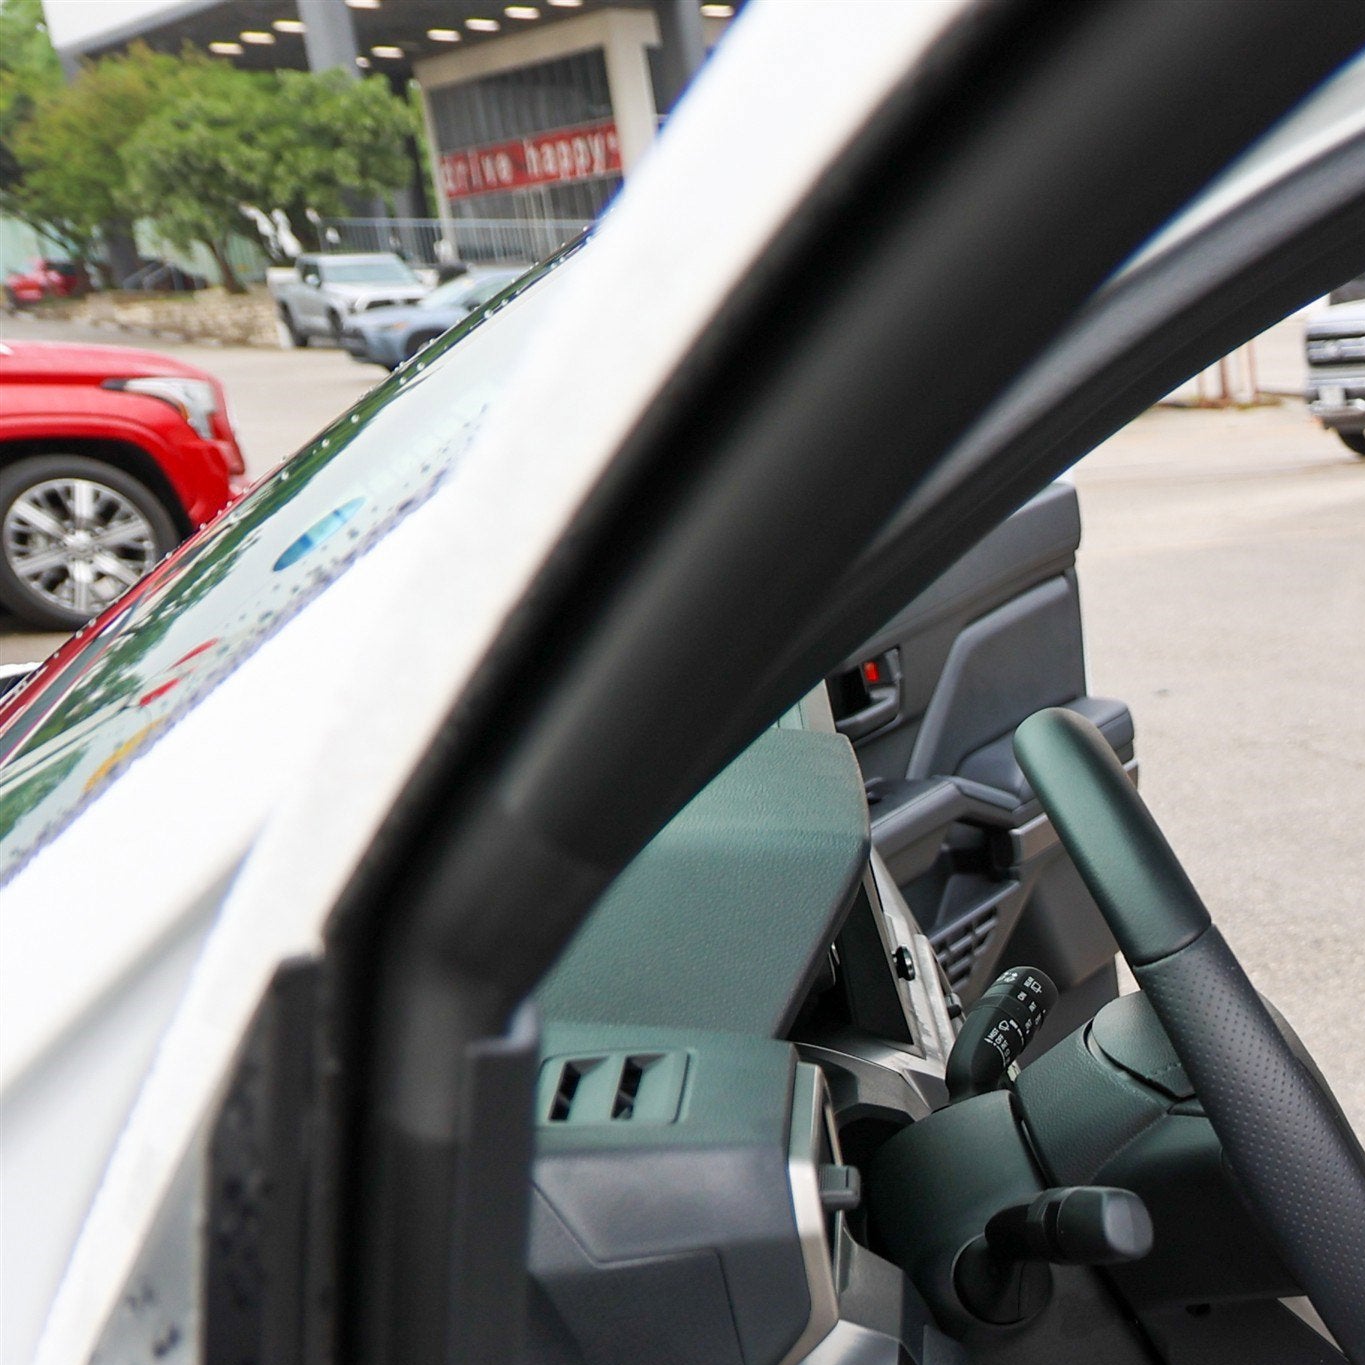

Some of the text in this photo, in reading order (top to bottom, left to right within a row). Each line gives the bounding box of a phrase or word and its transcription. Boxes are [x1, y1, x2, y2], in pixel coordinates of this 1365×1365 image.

[523, 131, 606, 182] happy
[1017, 992, 1027, 1001] ON
[988, 1028, 999, 1039] MIST
[995, 1034, 1004, 1044] OFF
